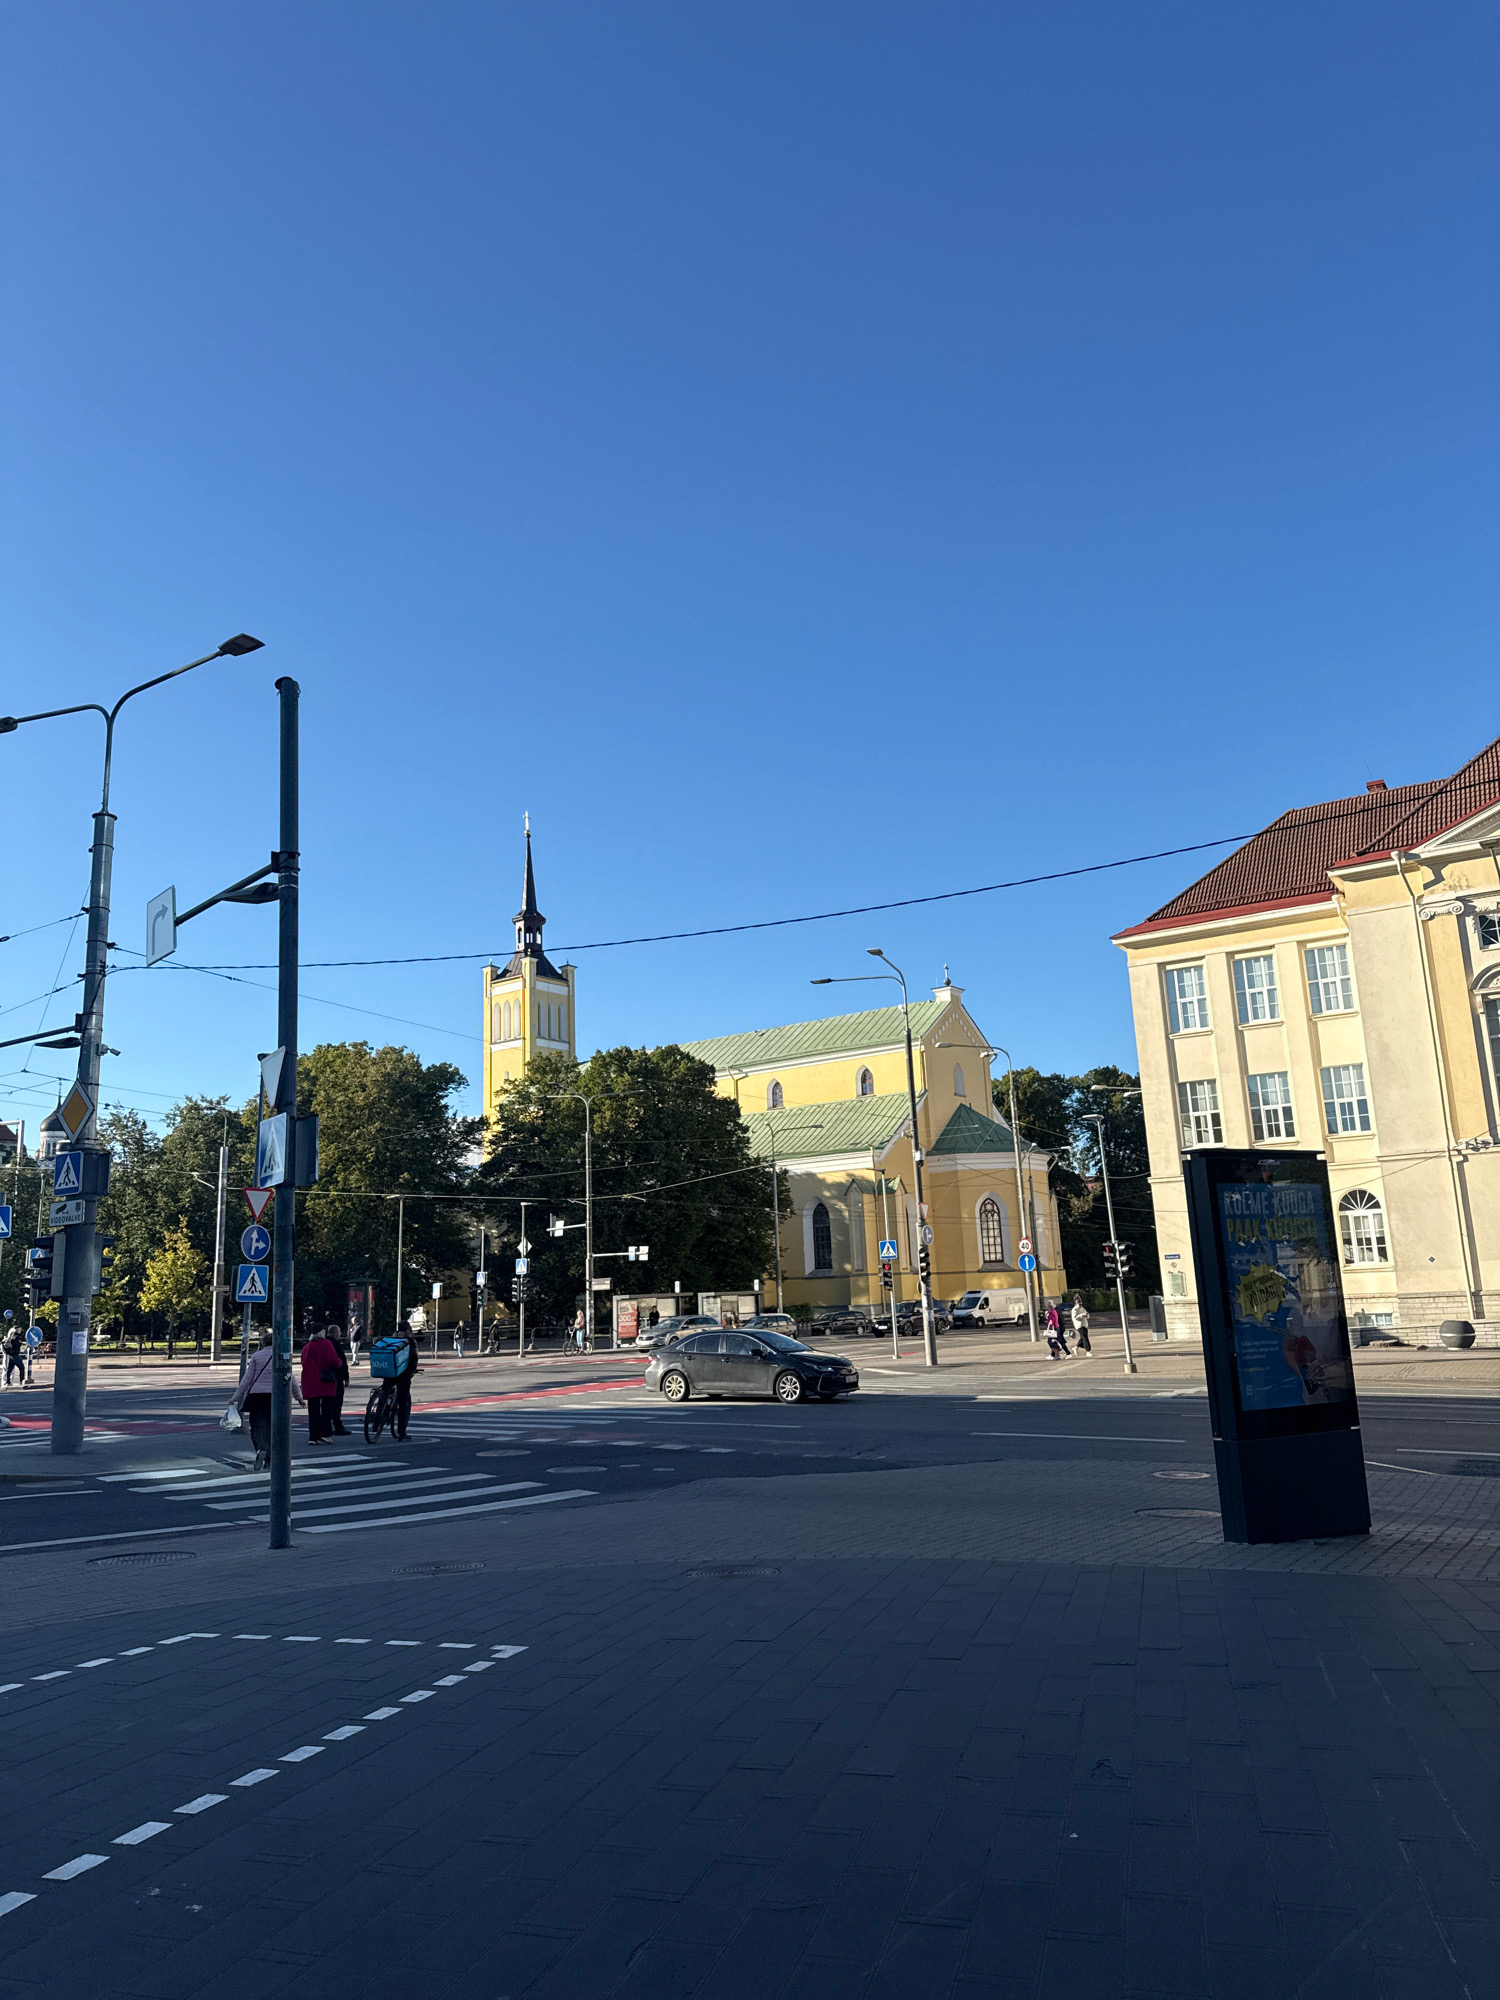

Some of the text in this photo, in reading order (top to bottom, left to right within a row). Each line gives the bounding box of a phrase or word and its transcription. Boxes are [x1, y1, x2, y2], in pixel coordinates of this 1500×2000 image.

[1223, 1189, 1315, 1215] KOLME KUUGA
[50, 1214, 81, 1224] VIDEOVALVE
[1226, 1218, 1262, 1241] PAAK
[1021, 1242, 1030, 1250] 40
[372, 1361, 389, 1369] Wolt
